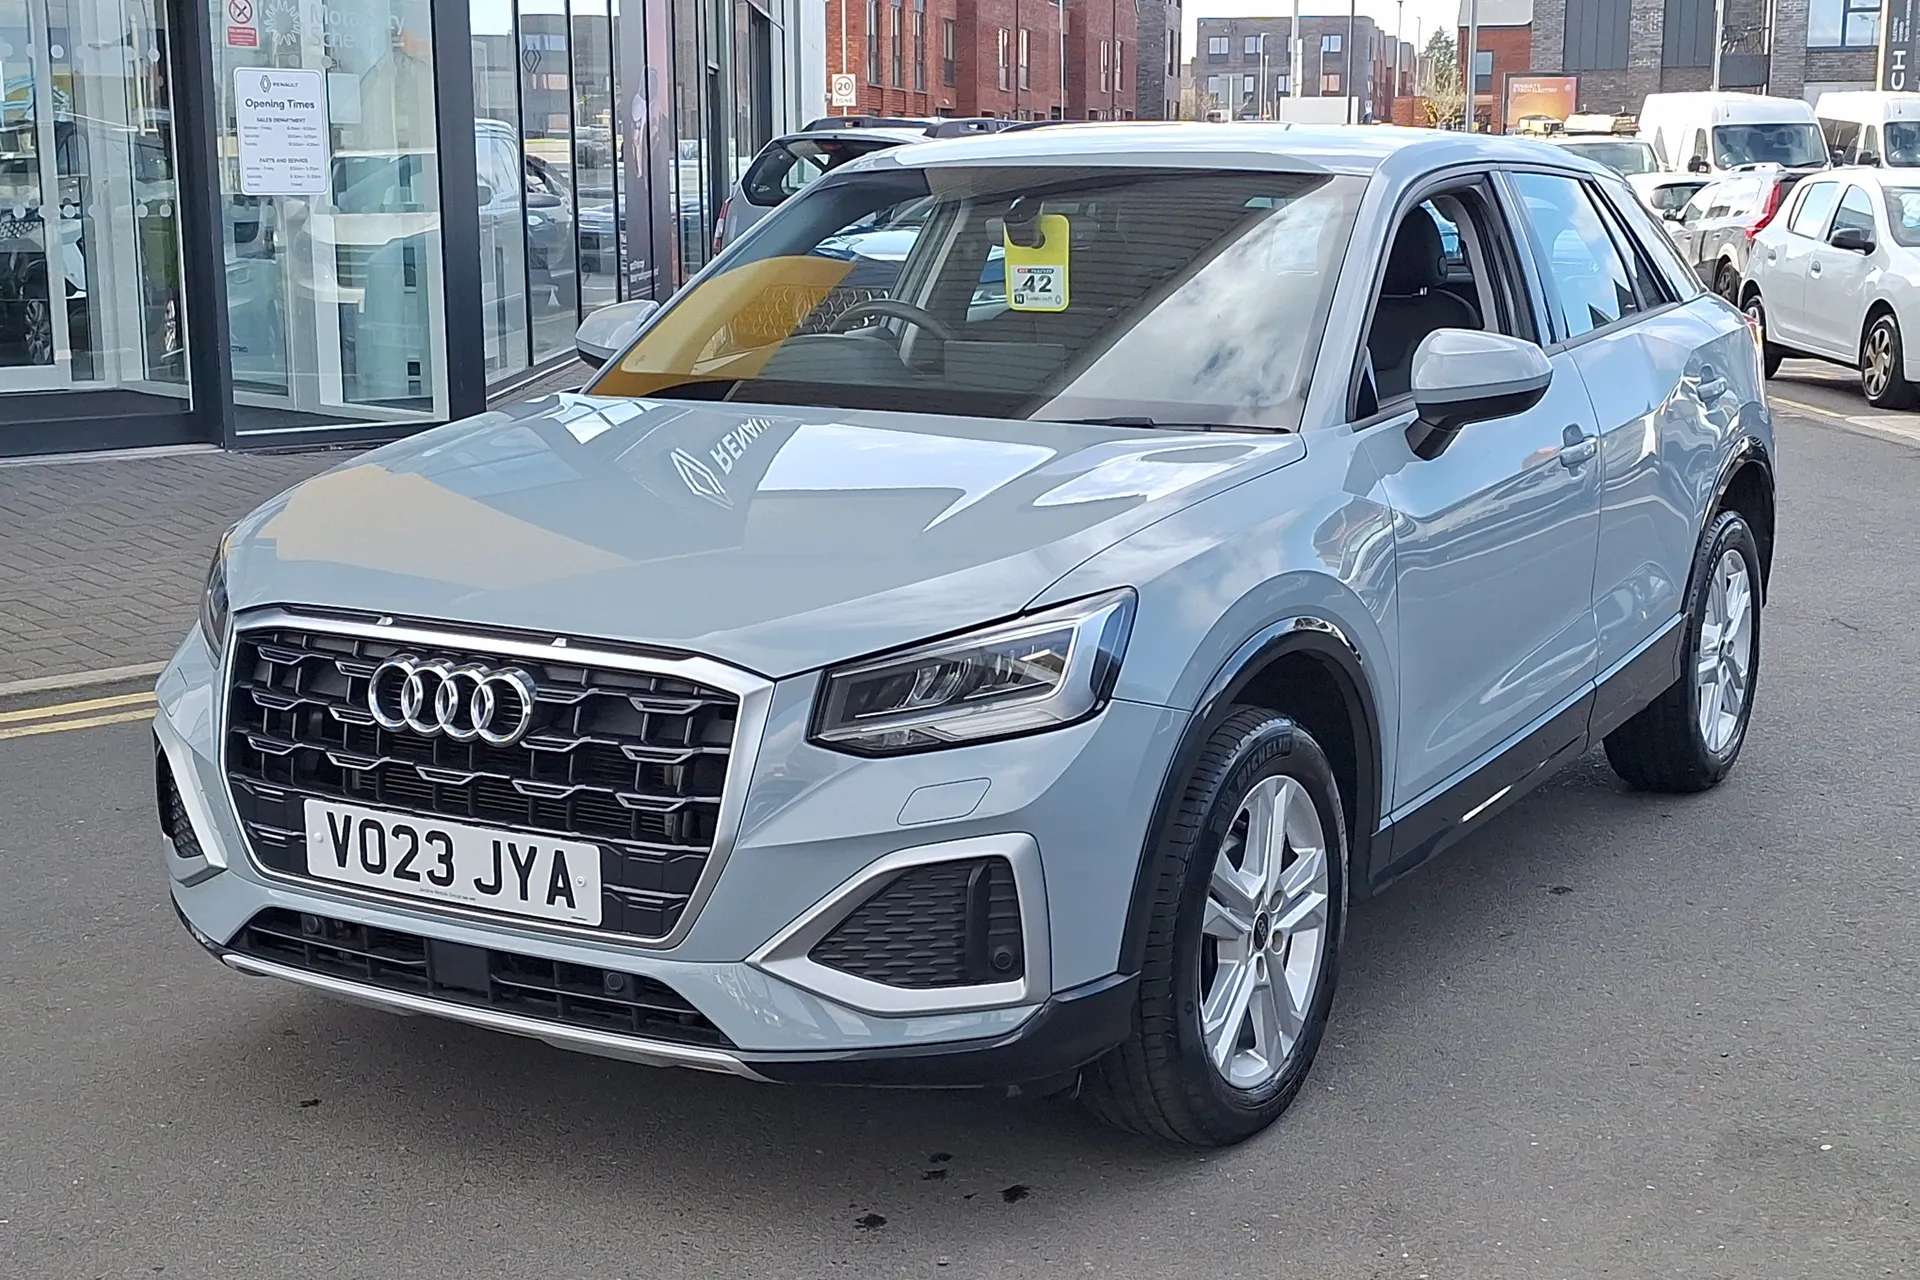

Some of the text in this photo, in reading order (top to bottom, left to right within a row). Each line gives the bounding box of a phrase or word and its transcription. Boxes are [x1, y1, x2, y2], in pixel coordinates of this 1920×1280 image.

[837, 82, 850, 91] 20
[245, 98, 315, 110] Opening Times
[1022, 275, 1052, 292] 42
[326, 811, 577, 909] VO23 JYA
